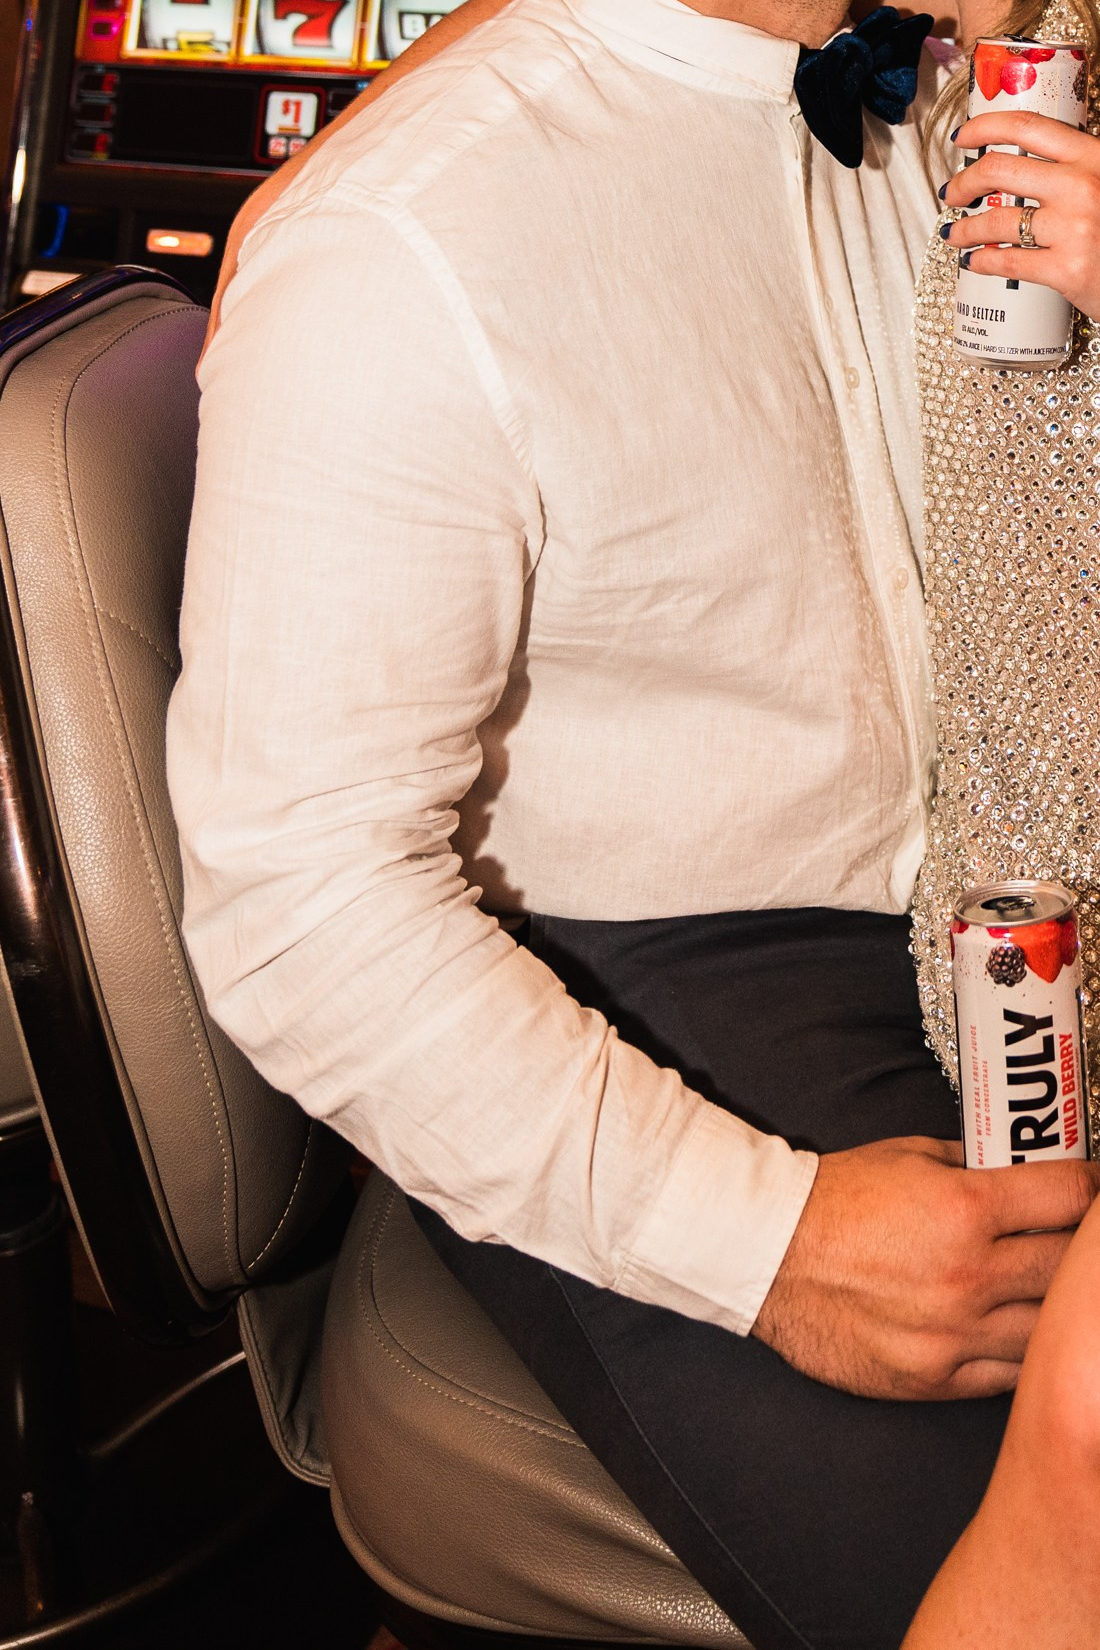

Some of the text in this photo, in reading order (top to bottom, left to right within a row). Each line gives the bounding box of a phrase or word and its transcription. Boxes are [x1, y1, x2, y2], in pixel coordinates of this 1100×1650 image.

[972, 306, 1006, 323] SELTZER
[1019, 347, 1033, 356] WITH
[970, 1024, 978, 1052] JUICE
[972, 1055, 980, 1083] FRUIT
[973, 1086, 981, 1109] REAL
[1059, 1032, 1079, 1151] WILD BERRY
[975, 1112, 983, 1137] WITH
